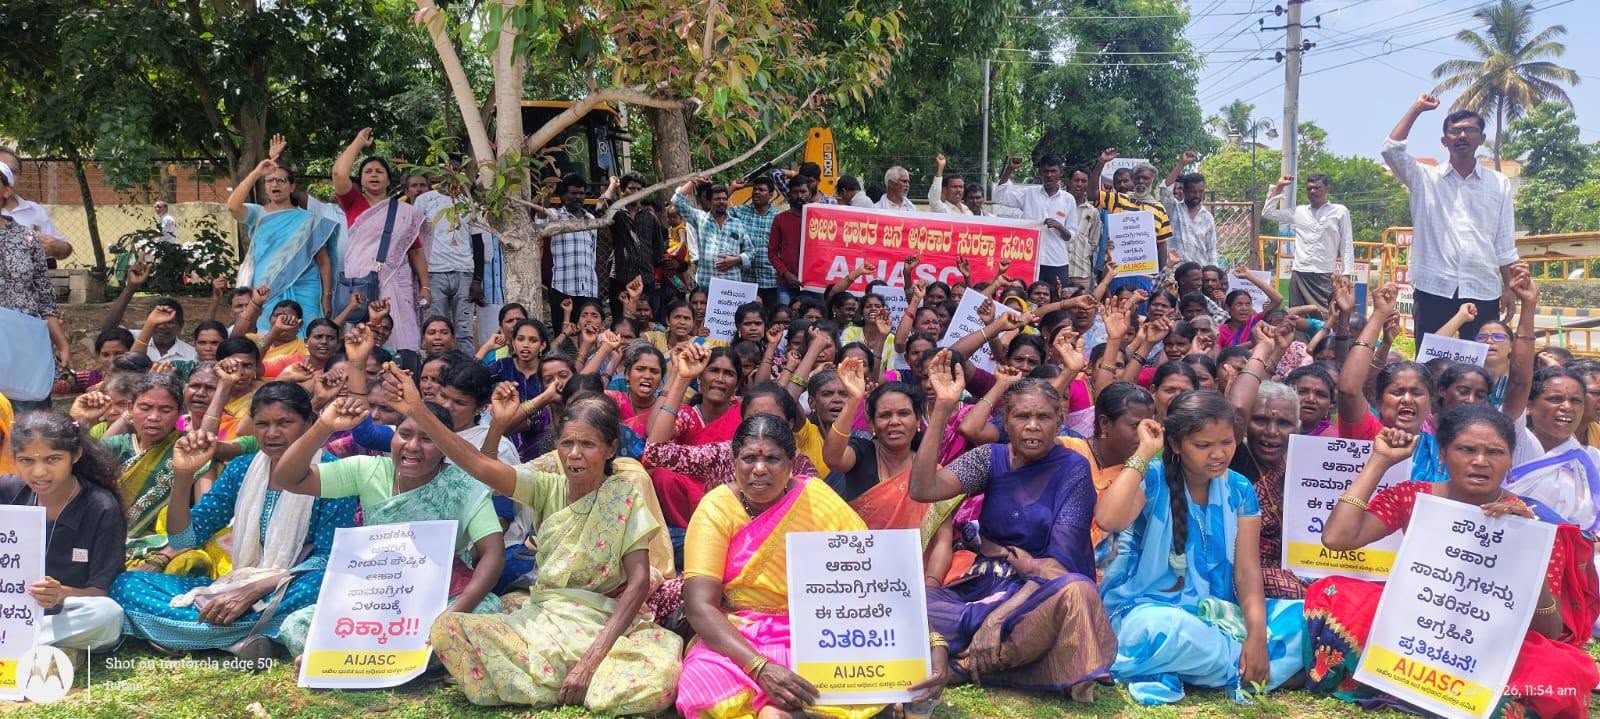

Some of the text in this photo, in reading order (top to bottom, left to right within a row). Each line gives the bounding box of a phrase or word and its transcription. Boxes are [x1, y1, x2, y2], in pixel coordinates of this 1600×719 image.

[842, 216, 878, 248] ಭಾರತ
[882, 219, 904, 249] ಜನ
[908, 224, 953, 255] ಅಧಿಕಾರ
[956, 226, 996, 270] ಸುರಕ್ಷಾ
[1001, 232, 1034, 261] ಸಮಿತಿ
[1327, 439, 1371, 459] ಪೌಷ್ಟಿಕ
[827, 534, 875, 553] ಪೌಷ್ಟಿಕ
[1451, 519, 1505, 548] ಪೌಷ್ಟಿಕ
[825, 557, 872, 572] ಆಹಾರ
[1319, 547, 1367, 562] AIJASC
[1445, 545, 1498, 569] ಆಹಾರ
[366, 571, 402, 581] ಆಹಾರ
[1410, 561, 1515, 610] ಸಾಮಗ್ರಿಗಳನ್ನು
[806, 578, 911, 598] ಸಾಮಾಗ್ರಿಗಳನ್ನು
[815, 603, 893, 619] ಈ ಕೂಡಲೇ
[1417, 586, 1491, 622] ವಿತರಿಸಲು
[334, 616, 420, 645] ಧಿಕ್ಕಾರ!!
[818, 628, 896, 648] ವಿತರಿಸಿ!!
[1416, 615, 1475, 645] ಆಗ್ರಹಿಸಿ
[343, 654, 397, 666] AIJASC
[1398, 635, 1477, 673] ಪ್ರತಿಭಟನೆ!
[833, 665, 886, 678] AIJASC
[1393, 657, 1466, 696] AIJASC
